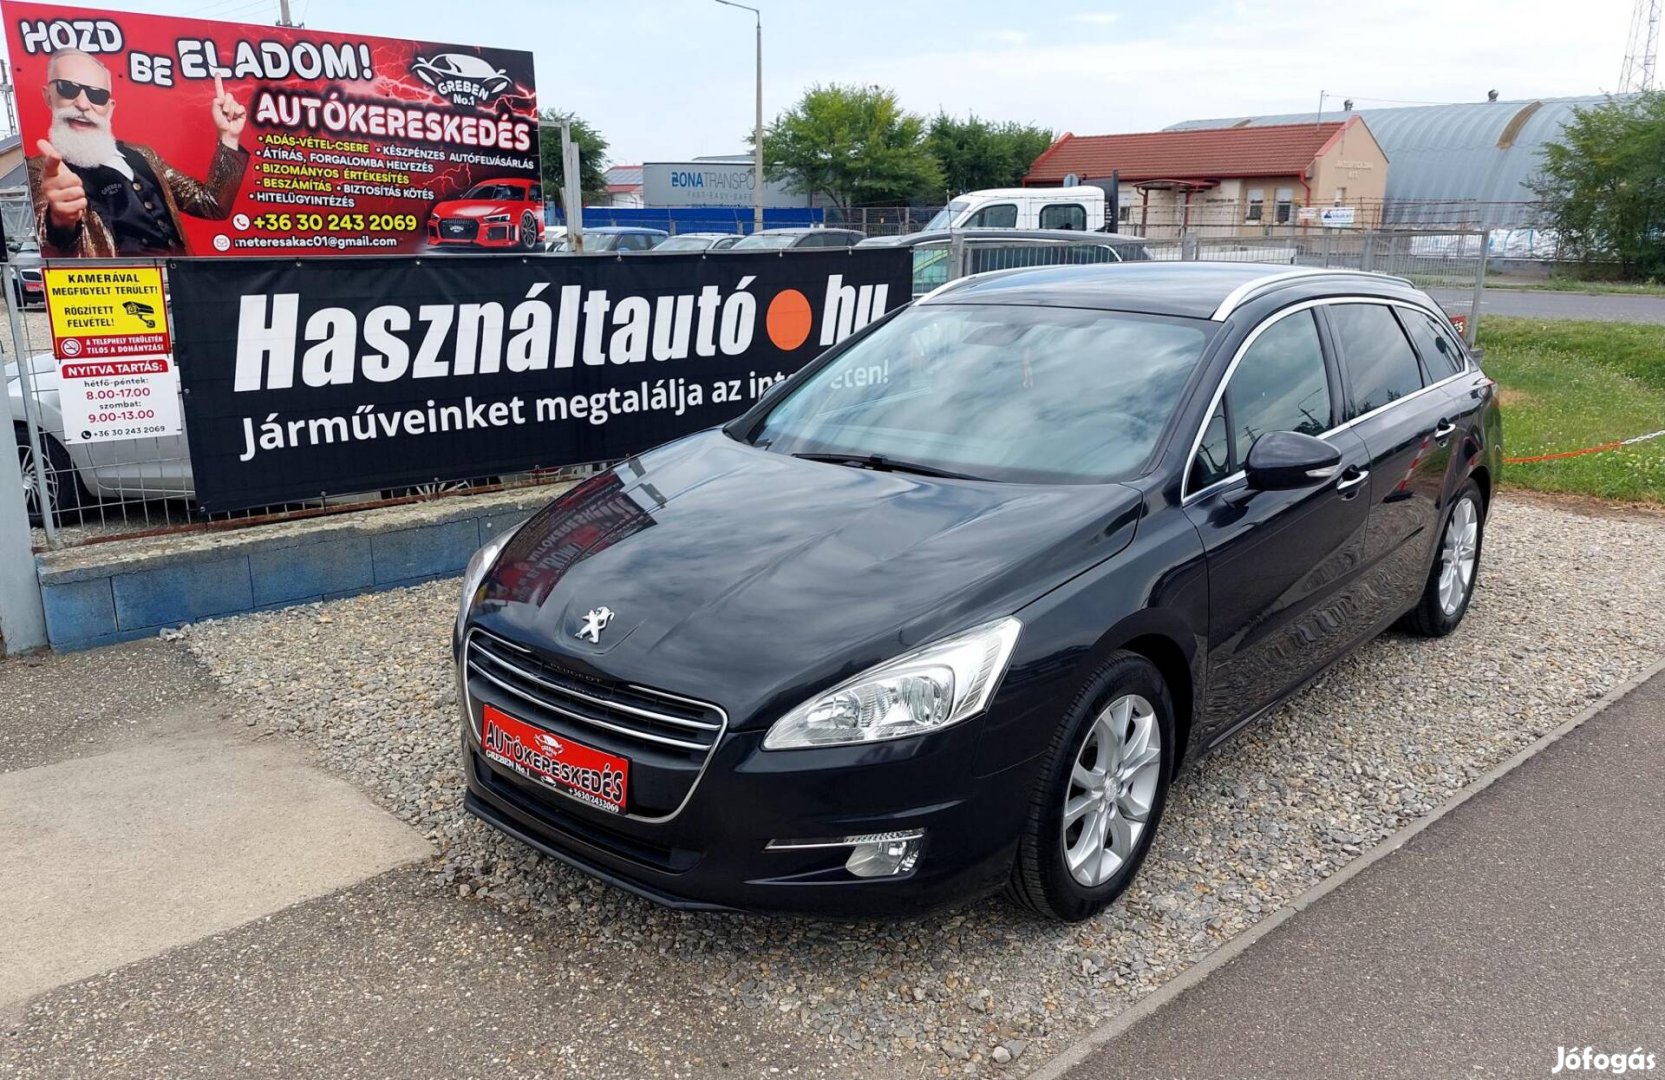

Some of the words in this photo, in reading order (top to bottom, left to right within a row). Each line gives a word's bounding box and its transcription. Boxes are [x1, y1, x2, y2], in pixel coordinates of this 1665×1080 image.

[20, 21, 123, 53] HOZD
[130, 52, 173, 87] BE
[177, 40, 373, 80] ELADOM!
[437, 79, 490, 101] GREBEN
[453, 93, 475, 106] No.1
[256, 92, 531, 151] AUTÓKERESKEDÉS
[265, 134, 370, 153] ADÁS-VÉTEL-CSERE
[263, 147, 307, 163] ÁTÍRÁS,
[310, 152, 385, 168] FORGALOMBA
[386, 160, 434, 173] HELYEZÉS
[383, 146, 446, 161] KÉSZPÉNZES
[449, 152, 535, 170] AUTÓFELVÁSÁRLÁS
[262, 163, 340, 179] BIZOMÁNYOS
[343, 169, 410, 185] ÉRTÉKESÍTÉS
[263, 178, 332, 192] BESZÁMÍTÁS
[343, 184, 401, 198] BIZTOSÍTÁS
[403, 187, 435, 200] KÖTÉS
[256, 192, 355, 208] HITELÜGYINTÉZÉS
[254, 214, 292, 231] +36
[297, 214, 323, 231] 30
[328, 214, 365, 231] 243
[369, 214, 417, 231] 2069
[68, 272, 140, 284] KAMERÁVAL
[52, 287, 112, 296] MEGFIGYELT
[116, 284, 158, 295] TERÜLET!
[64, 304, 114, 316] RÖGZÍTETT
[67, 317, 115, 328] FELVÉTEL!
[92, 337, 127, 346] TELEPHELY
[233, 275, 757, 392] Használtautó
[67, 365, 115, 377] NYITVA
[116, 361, 163, 373] TARTÁS:
[86, 387, 151, 401] 8.00-17.00
[99, 401, 142, 410] szombat:
[88, 409, 155, 424] 9.00-13.00
[239, 396, 526, 462] Járműveinket
[535, 377, 703, 426] megtalálja
[711, 376, 743, 403] az
[94, 429, 110, 437] +36
[112, 428, 124, 436] 30
[126, 427, 142, 435] 243
[144, 425, 166, 434] 2069
[485, 720, 624, 804] AUTÓKERESKEDÉS
